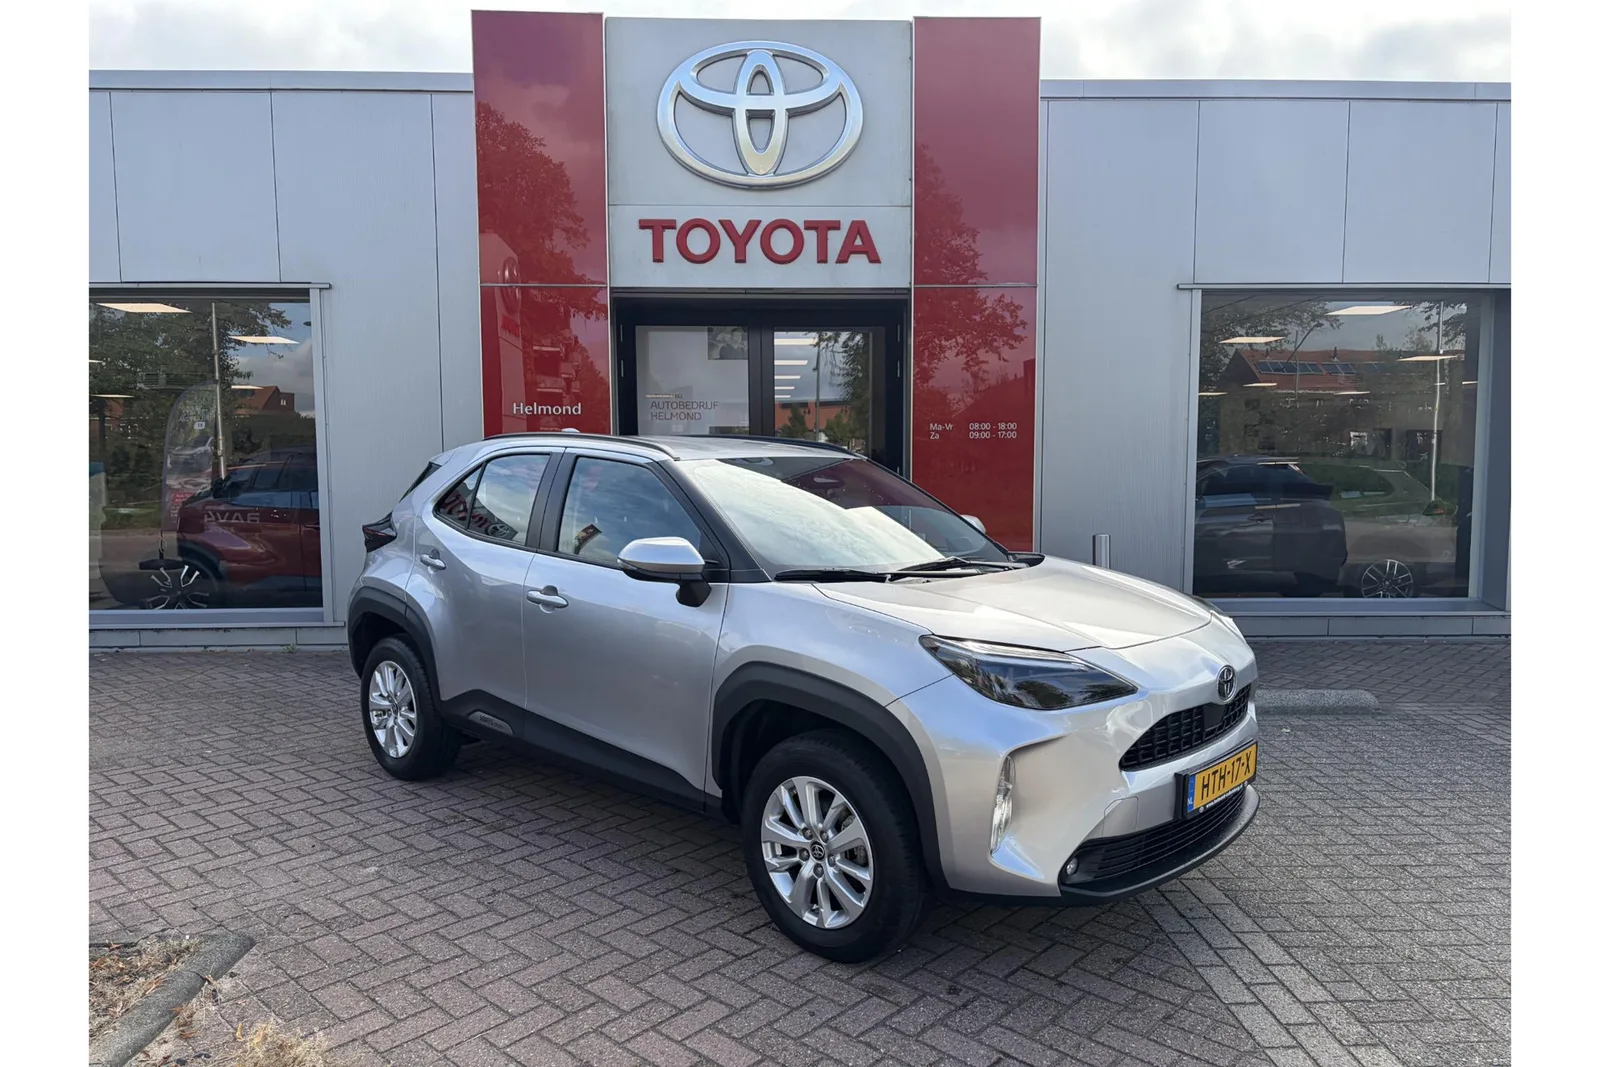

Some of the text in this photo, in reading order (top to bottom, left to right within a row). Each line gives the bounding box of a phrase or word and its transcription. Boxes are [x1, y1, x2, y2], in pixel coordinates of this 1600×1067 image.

[638, 218, 882, 264] TOYOTA
[512, 402, 582, 415] Helmond
[650, 401, 719, 410] AUTOBEDRIJF
[650, 411, 702, 420] HELMOND
[929, 423, 954, 431] Ma-Vr
[969, 422, 991, 430] 08:00
[997, 422, 1018, 430] 18:00
[929, 432, 940, 440] Za
[969, 431, 991, 439] 09:00
[997, 431, 1018, 439] 17:00
[1201, 750, 1252, 800] HTH-17-X
